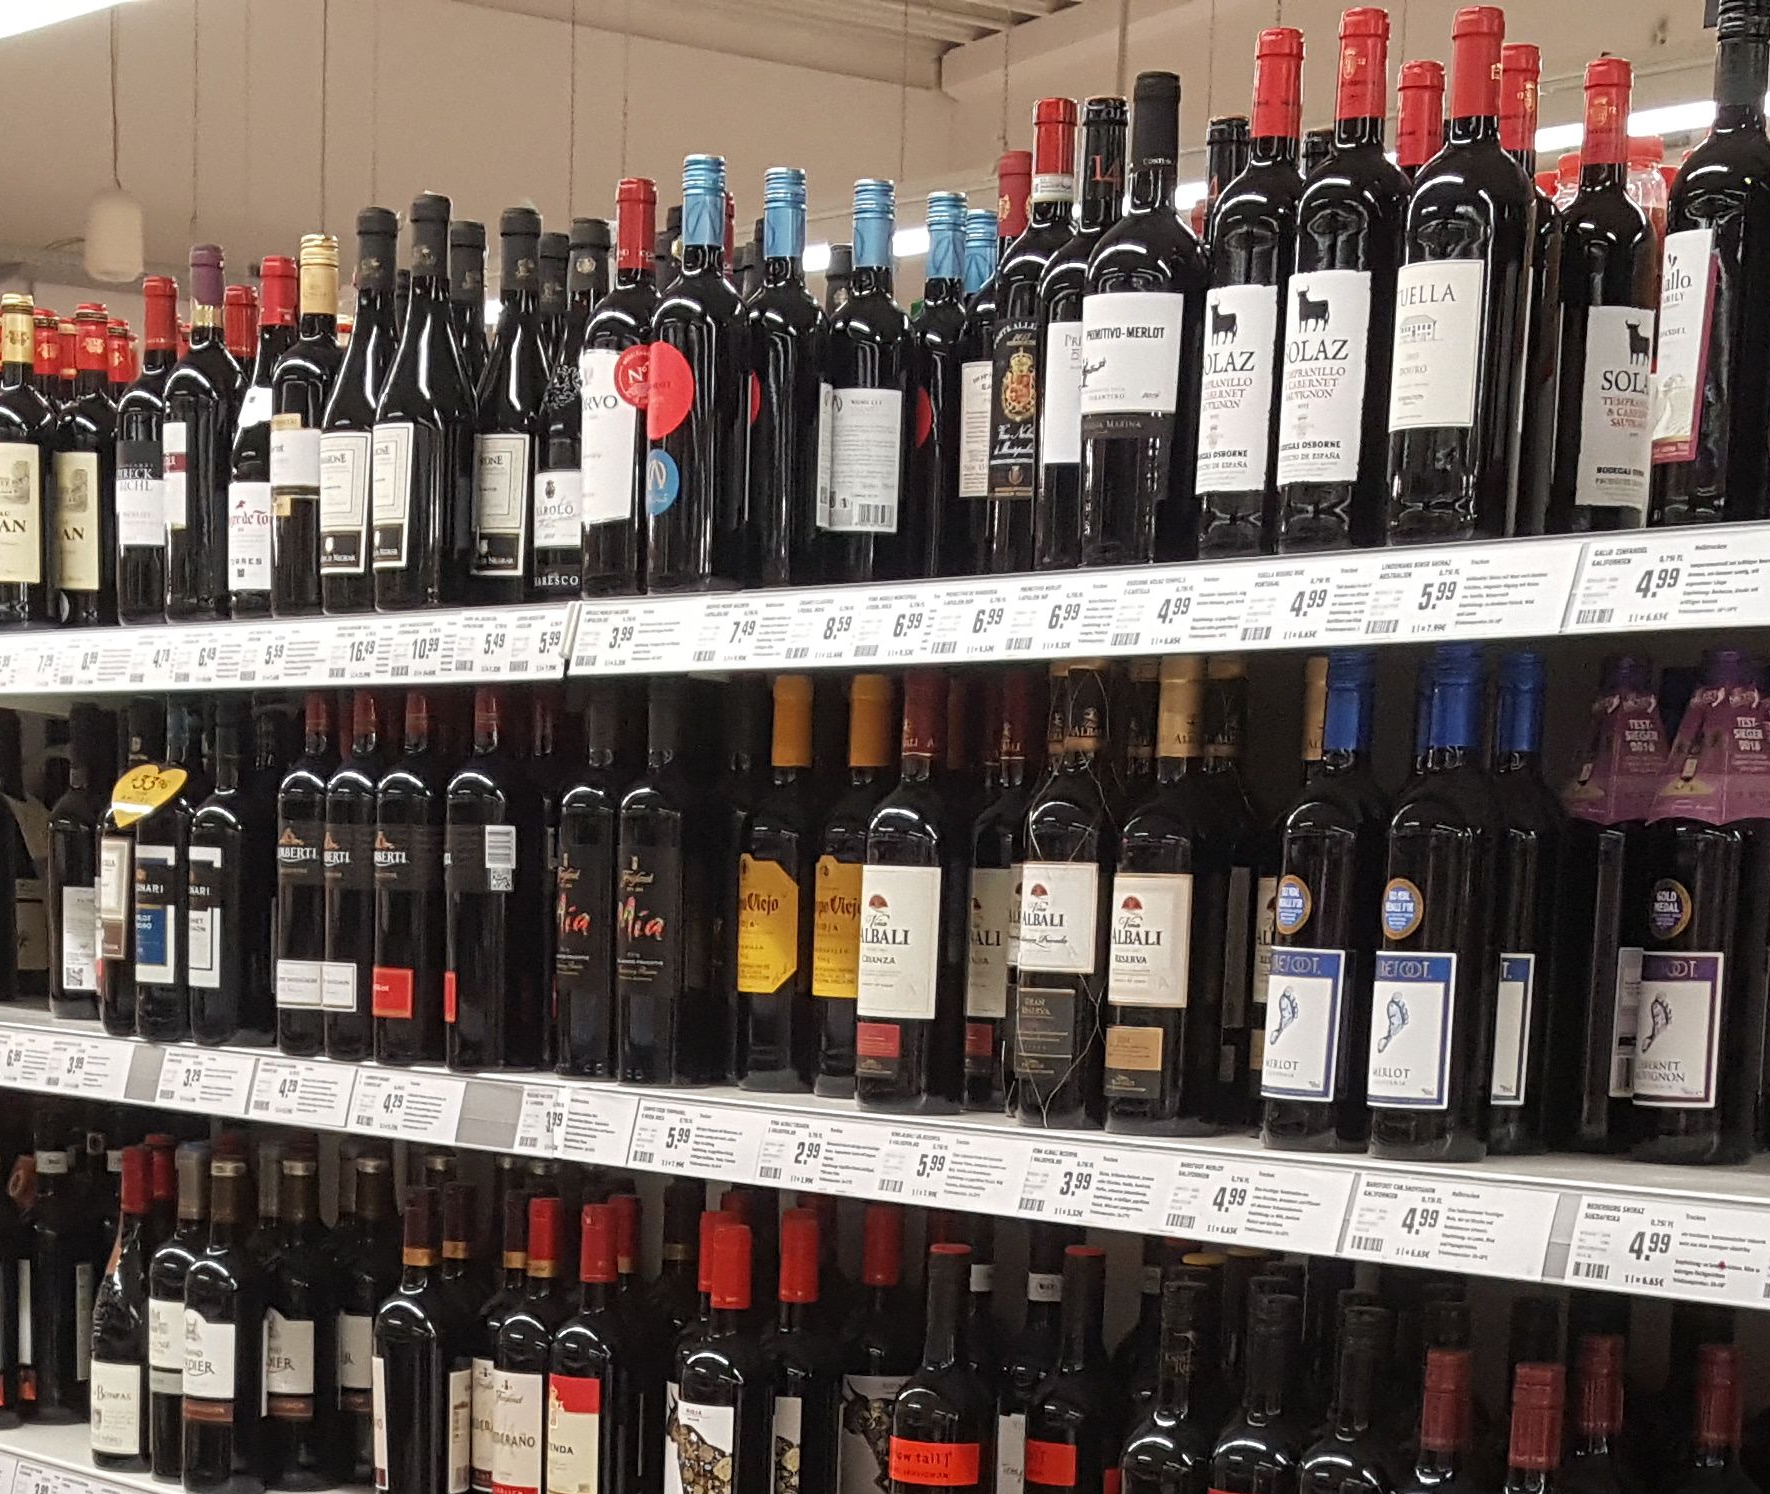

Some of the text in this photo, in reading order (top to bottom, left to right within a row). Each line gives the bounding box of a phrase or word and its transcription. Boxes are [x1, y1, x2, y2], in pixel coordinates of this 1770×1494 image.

[1204, 351, 1255, 375] OLAZ
[1302, 440, 1341, 449] OSBORNE
[1418, 581, 1457, 611] 5.99
[1635, 567, 1681, 599] 4.99
[1157, 597, 1191, 624] 4.99
[1289, 588, 1328, 618] 4.99
[824, 616, 852, 640] 8.59
[893, 612, 923, 638] 6.99
[972, 608, 1004, 634] 6.99
[1048, 603, 1081, 630] 6.99
[539, 631, 561, 655] 5.99
[609, 626, 634, 650] 3.99
[729, 620, 756, 644] 7.49
[665, 1123, 692, 1149] 5.99
[794, 1140, 821, 1166] 2.99
[917, 1153, 946, 1179] 5.99
[1059, 1170, 1091, 1198] 3.99
[1212, 1186, 1247, 1213] 4.99
[1401, 1207, 1440, 1236] 4.99
[1628, 1230, 1672, 1262] 4.99
